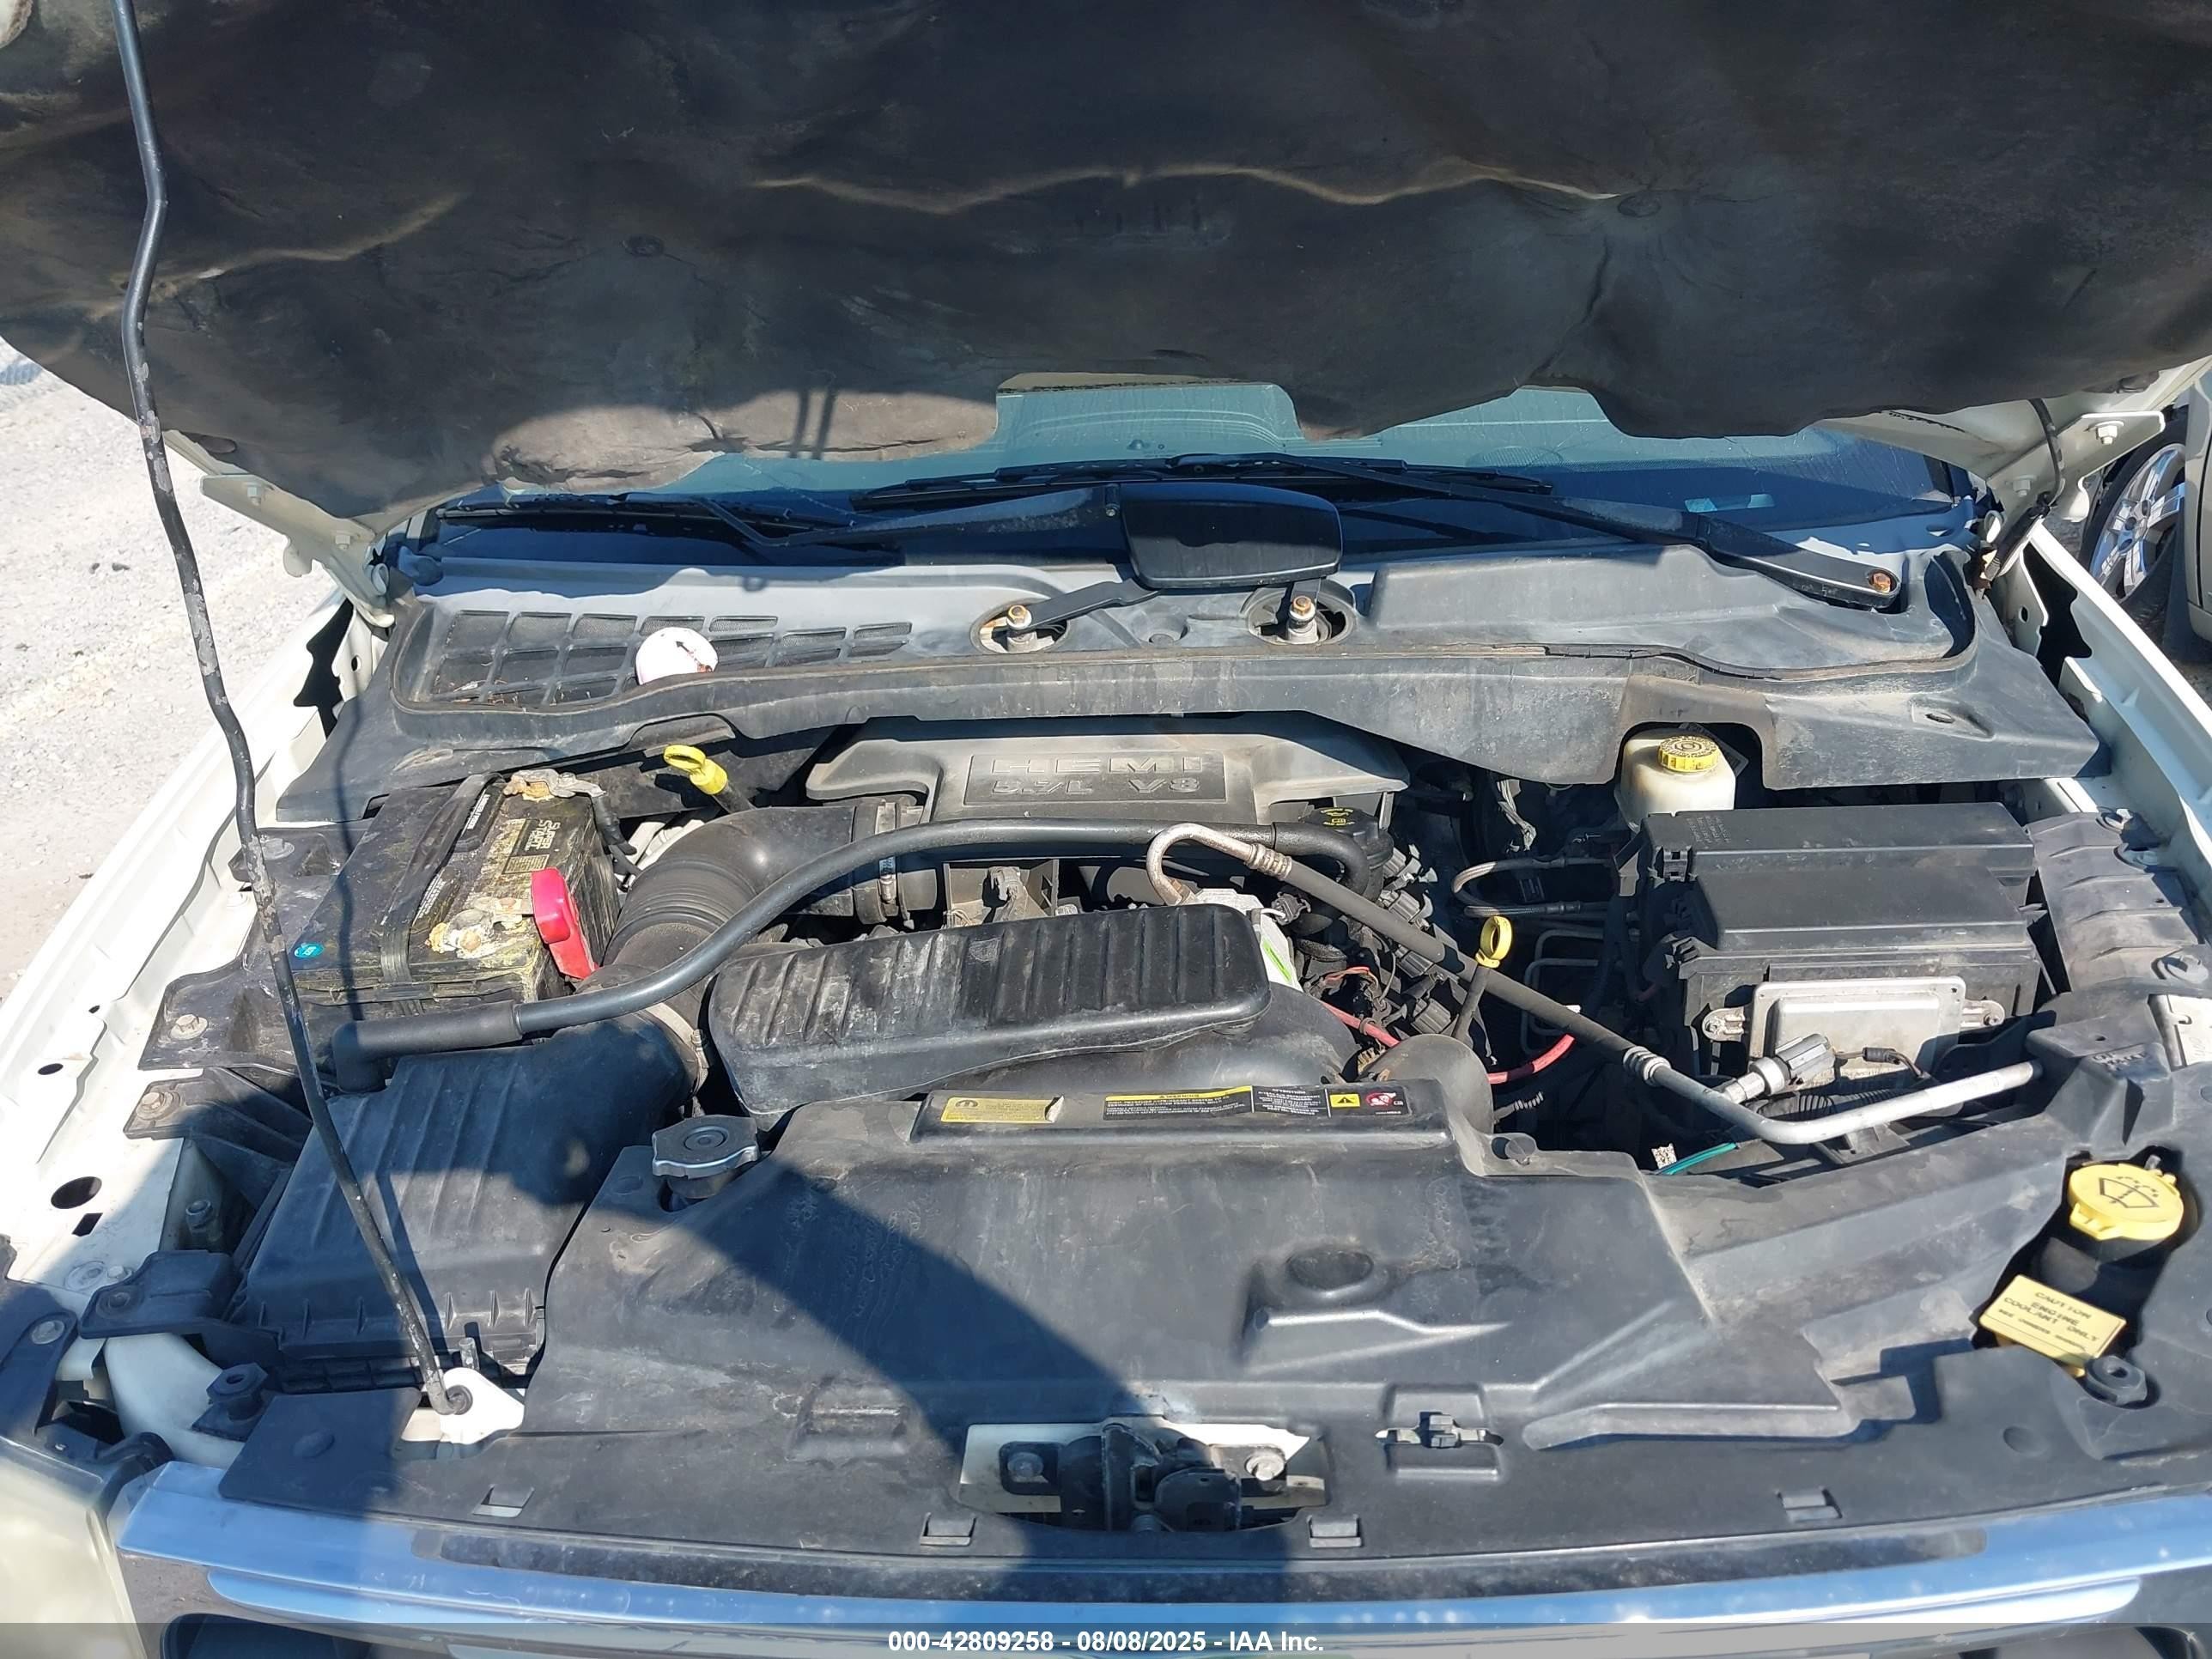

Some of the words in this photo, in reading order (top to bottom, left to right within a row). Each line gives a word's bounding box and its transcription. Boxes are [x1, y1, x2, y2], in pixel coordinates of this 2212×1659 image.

[992, 757, 1201, 774] HEMI
[992, 780, 1093, 795] 5.7L
[1128, 777, 1200, 794] V8
[530, 819, 553, 850] START
[539, 822, 561, 849] SUPER
[2032, 1303, 2080, 1325] ENGINE
[2035, 1292, 2092, 1319] CAUTION
[2004, 1297, 2058, 1324] COOLANT
[2066, 1325, 2099, 1342] ONLY
